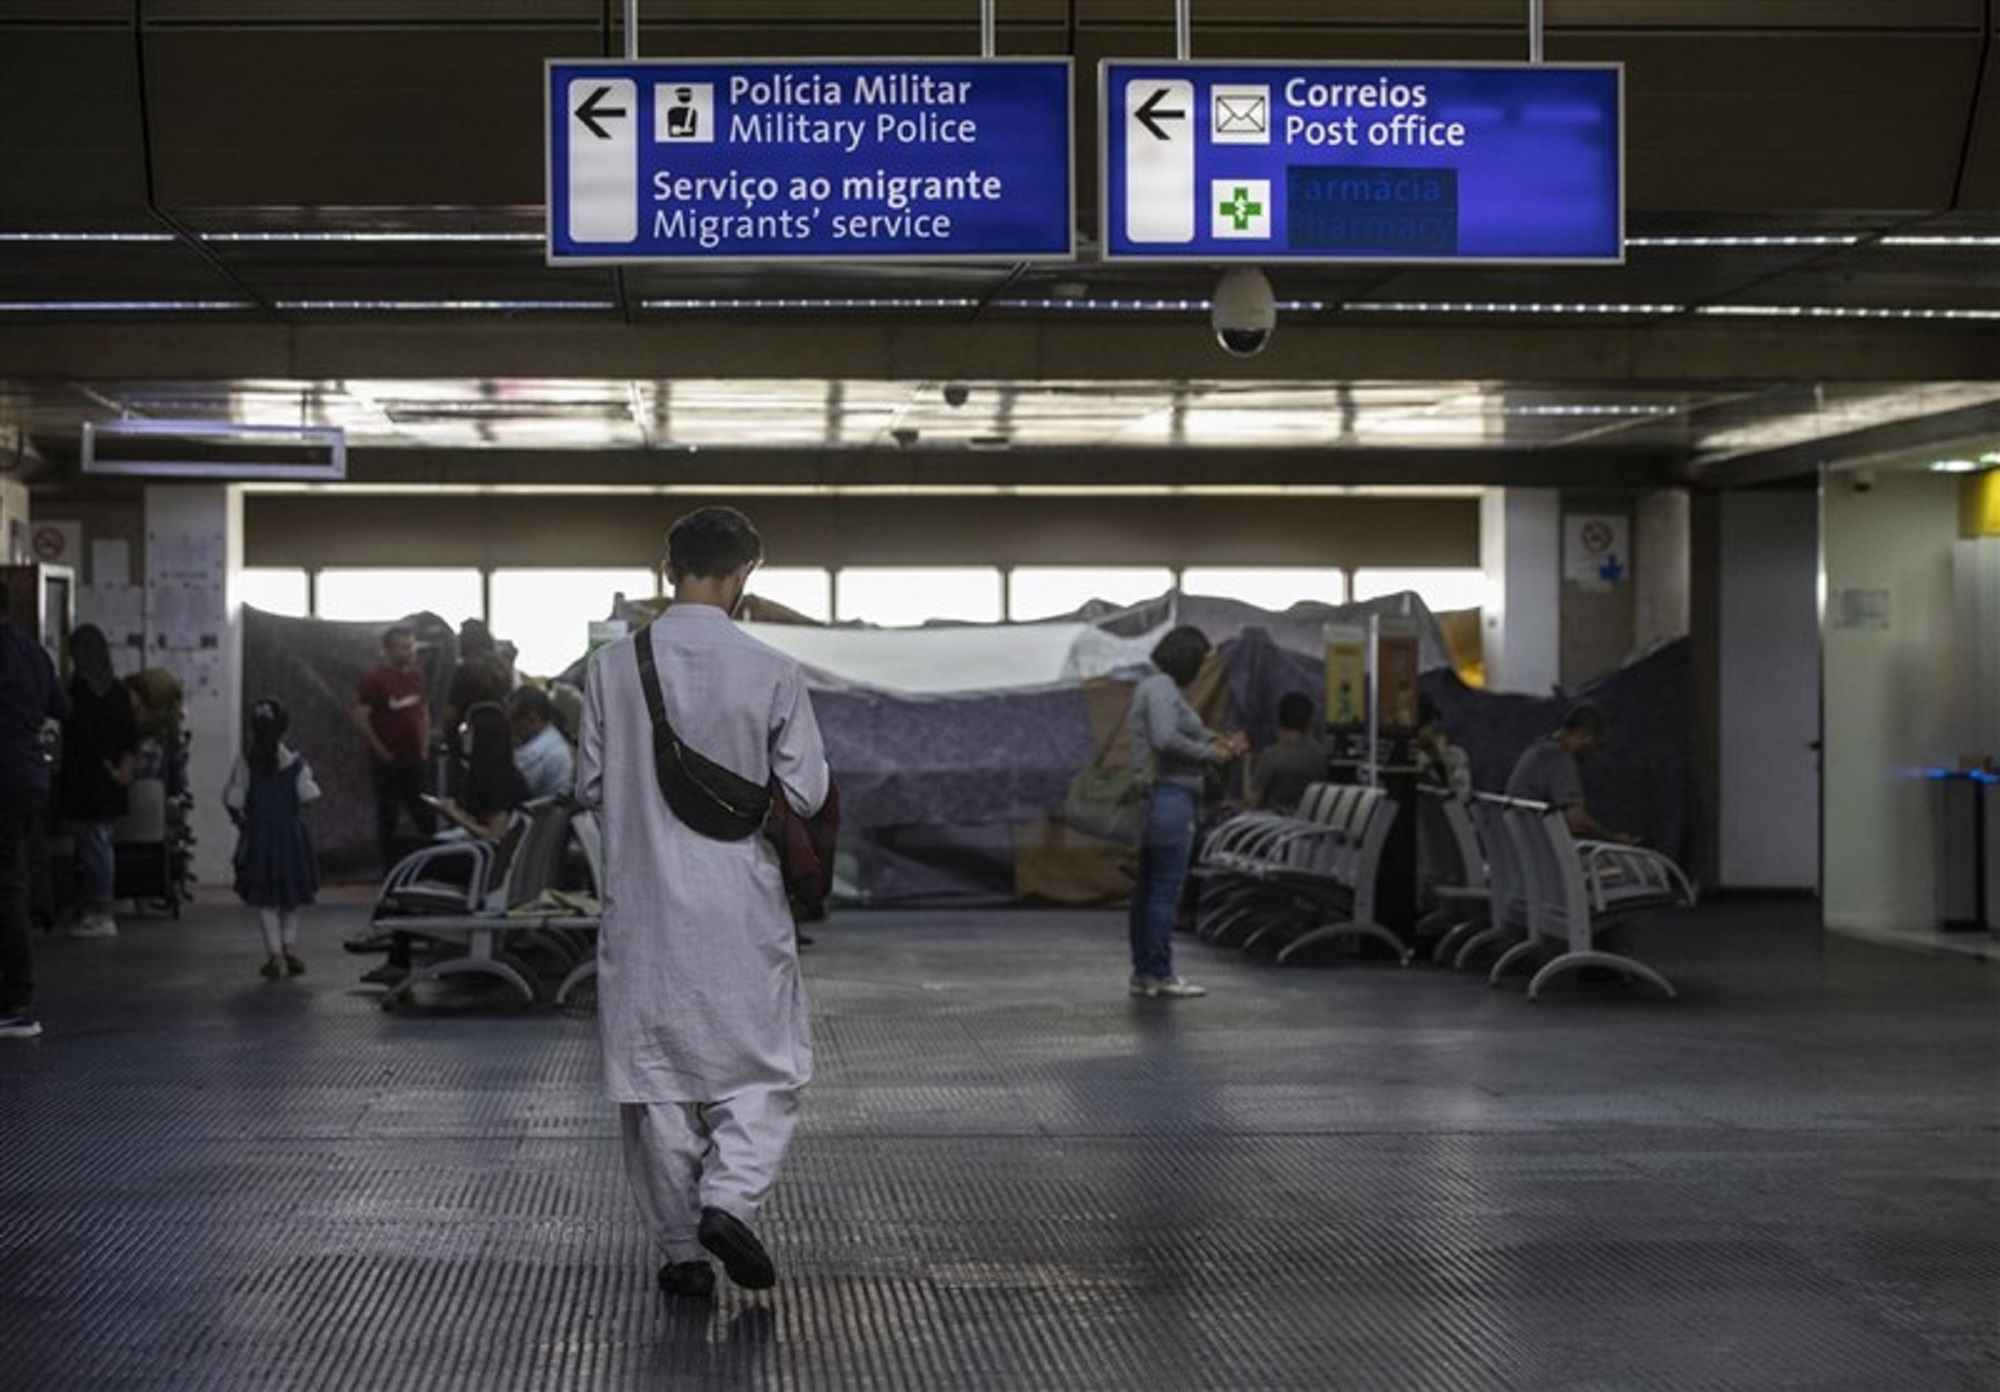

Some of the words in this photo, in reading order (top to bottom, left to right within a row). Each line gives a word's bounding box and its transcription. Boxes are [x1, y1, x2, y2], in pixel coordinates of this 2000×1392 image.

[730, 74, 842, 105] Polícia
[854, 74, 971, 105] Militar
[1285, 77, 1427, 107] Correios
[730, 113, 866, 153] Military
[877, 112, 977, 143] Police
[1286, 116, 1359, 146] Post
[1368, 114, 1465, 146] office
[653, 170, 779, 208] Serviço
[789, 177, 831, 201] ao
[842, 170, 1002, 208] migrante
[832, 209, 951, 239] service
